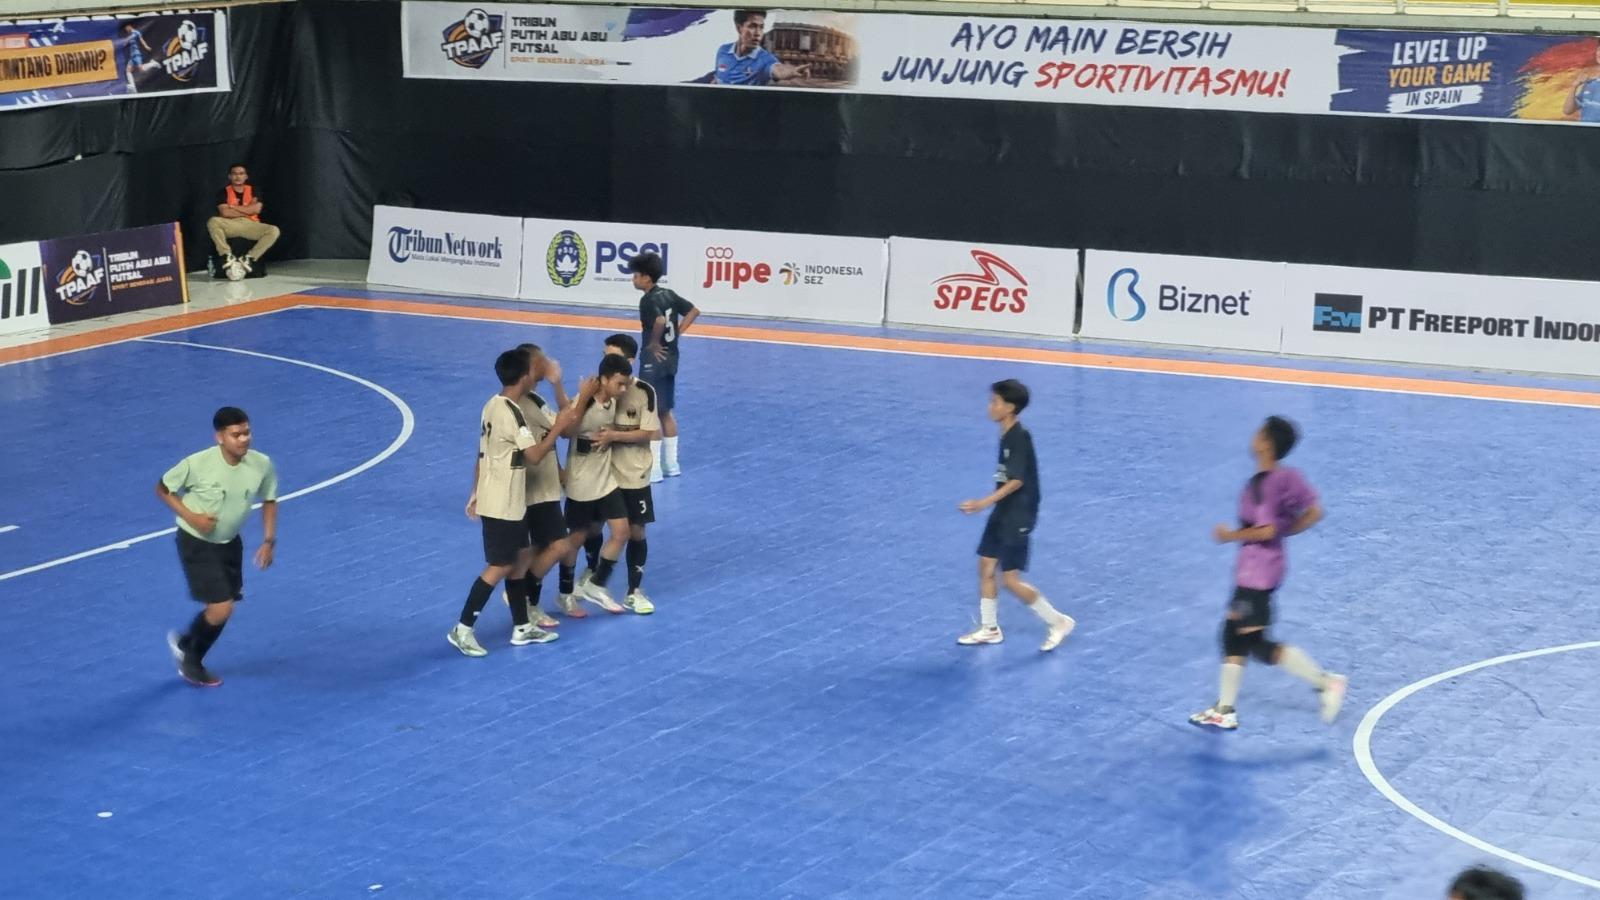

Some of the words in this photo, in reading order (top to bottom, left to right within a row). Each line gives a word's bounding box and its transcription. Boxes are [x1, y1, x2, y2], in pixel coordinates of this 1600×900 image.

[511, 30, 547, 41] PUTIH
[552, 31, 577, 41] ABU
[581, 31, 608, 42] ABU
[512, 16, 556, 27] TRIBUN
[441, 31, 504, 60] TPAAF
[511, 43, 558, 54] FUTSAL
[951, 22, 1017, 52] AYO
[1025, 26, 1107, 56] MAIN
[1115, 28, 1232, 59] BERSIH
[1392, 39, 1450, 66] LEVEL
[1457, 36, 1488, 61] UP
[54, 49, 107, 75] DIRIMU?
[162, 42, 209, 75] TPAAF
[882, 56, 1028, 88] JUNJUNG
[1034, 61, 1291, 98] SPORTIVITASMU!
[1388, 65, 1436, 88] YOUR
[1441, 62, 1493, 84] GAME
[1406, 91, 1420, 106] IN
[1424, 89, 1463, 105] SPAIN
[56, 267, 104, 301] TPAAF
[110, 270, 143, 283] FUTSAL
[703, 260, 771, 290] jiipe
[804, 275, 823, 285] SEZ
[805, 264, 863, 276] INDONESIA
[933, 284, 1028, 314] SPECS
[1158, 284, 1250, 316] Biznet
[665, 307, 675, 343] 5
[1369, 306, 1405, 330] PT
[1409, 308, 1529, 338] FREEPORT
[639, 500, 647, 514] 3
